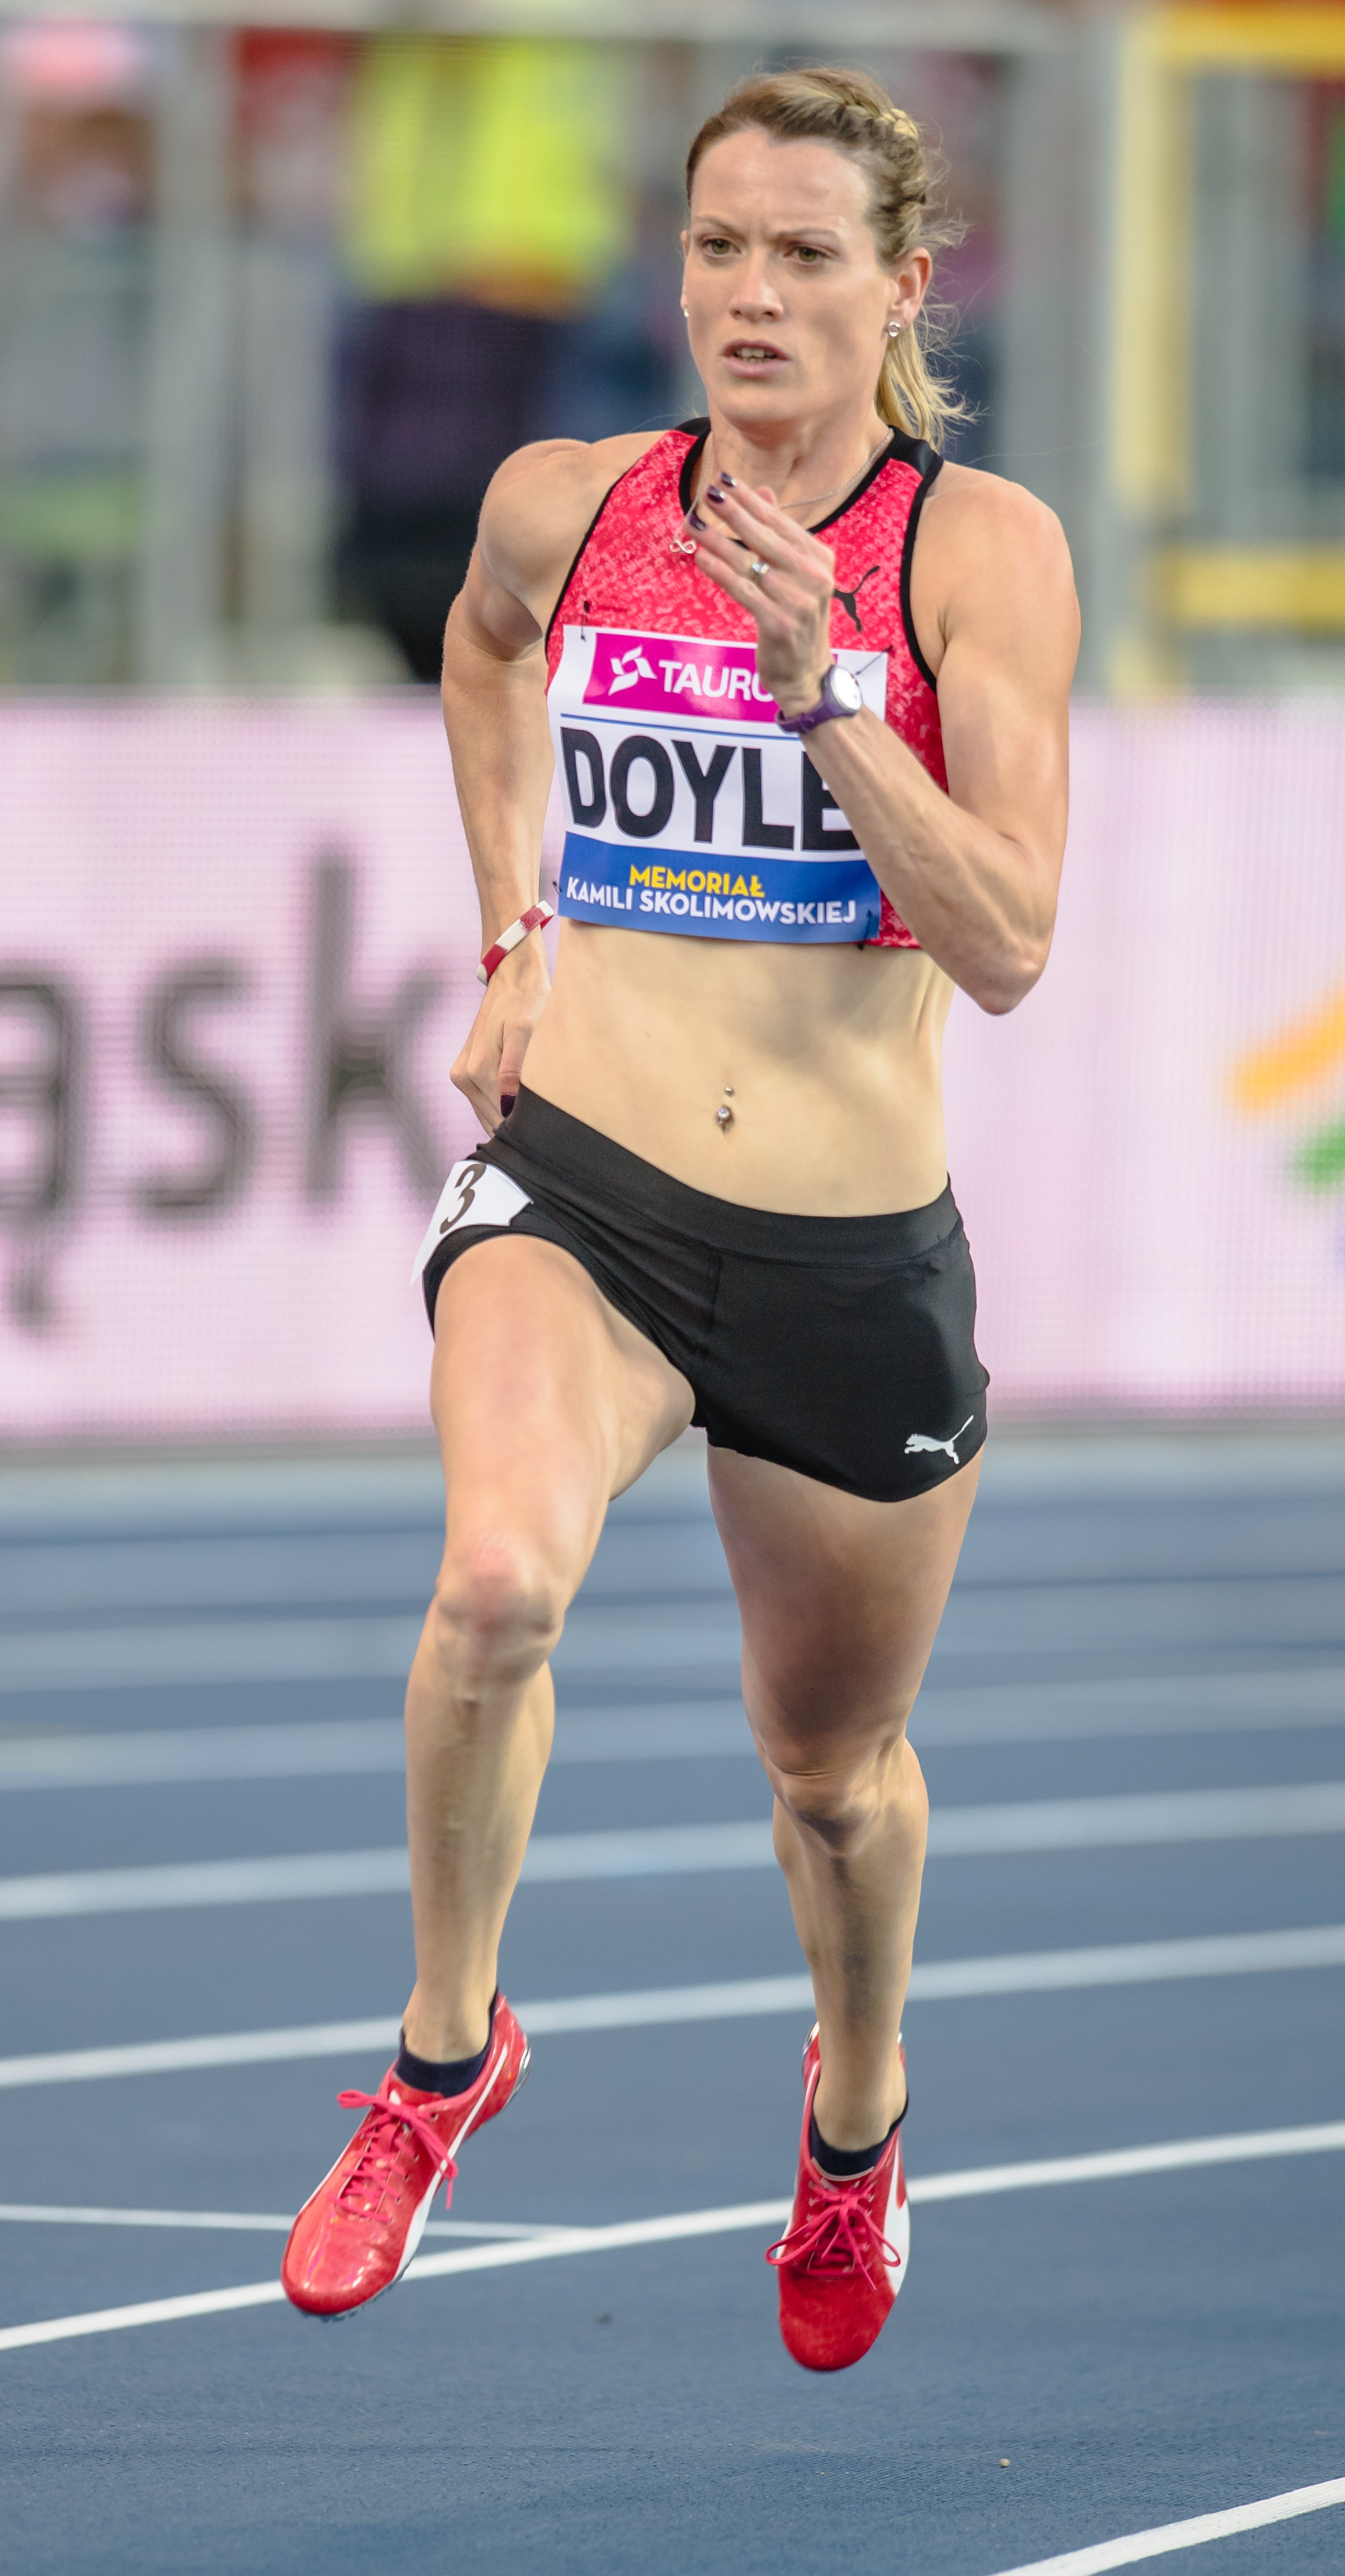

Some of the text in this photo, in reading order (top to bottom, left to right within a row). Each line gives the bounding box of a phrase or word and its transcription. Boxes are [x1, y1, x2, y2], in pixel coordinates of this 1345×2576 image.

[560, 726, 861, 852] DOYLE
[566, 876, 856, 925] KAMILI SKOLIMOWSKIEJ
[629, 863, 766, 898] MEMORIAŁ
[439, 1163, 487, 1235] 3
